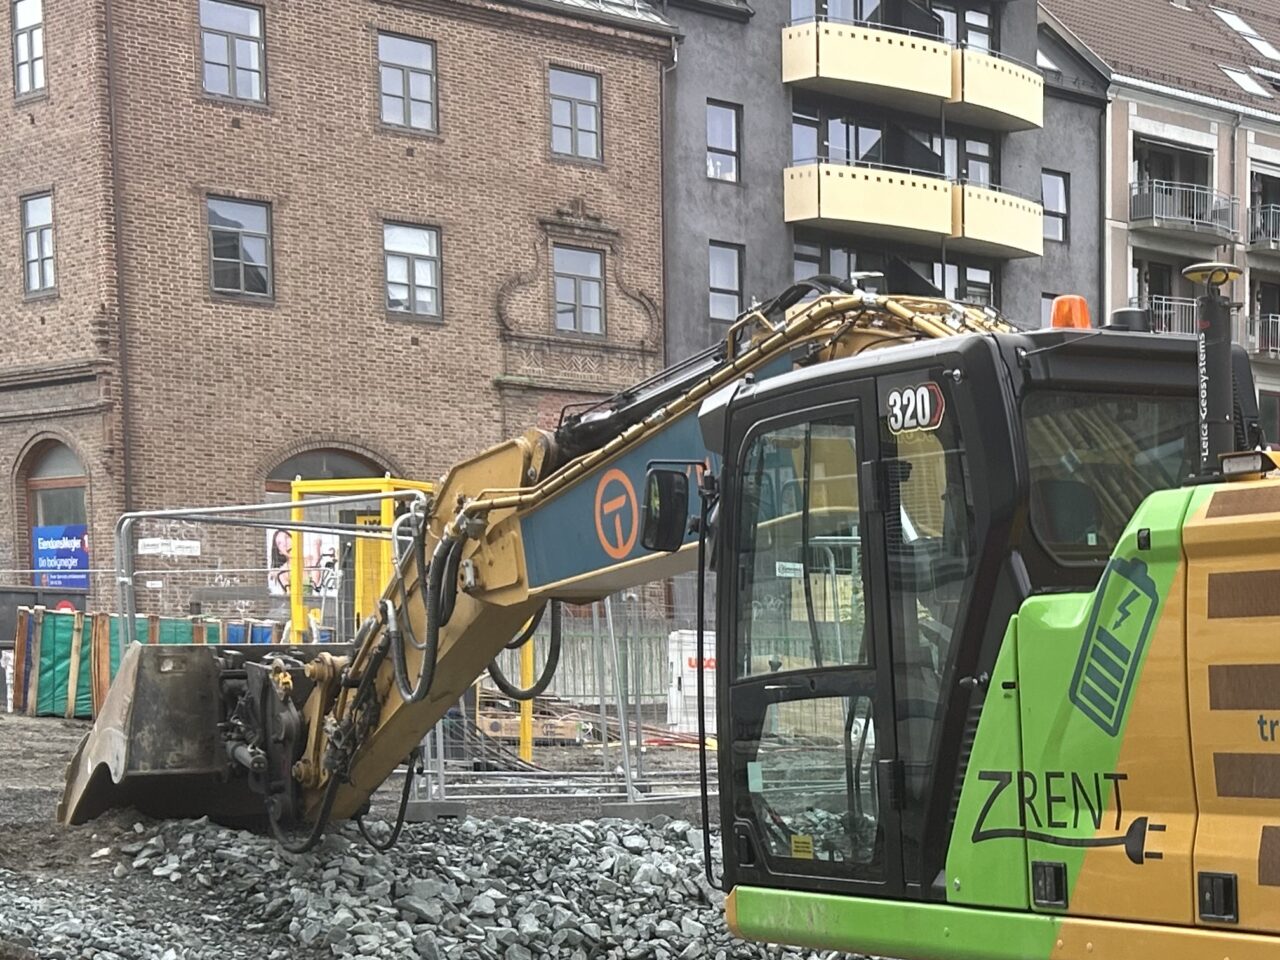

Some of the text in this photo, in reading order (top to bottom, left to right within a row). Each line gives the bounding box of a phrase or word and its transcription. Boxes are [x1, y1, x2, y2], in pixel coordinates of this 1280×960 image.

[888, 386, 931, 430] 320
[1199, 332, 1210, 458] Leica Geosystems
[971, 771, 1128, 844] ZRENT
